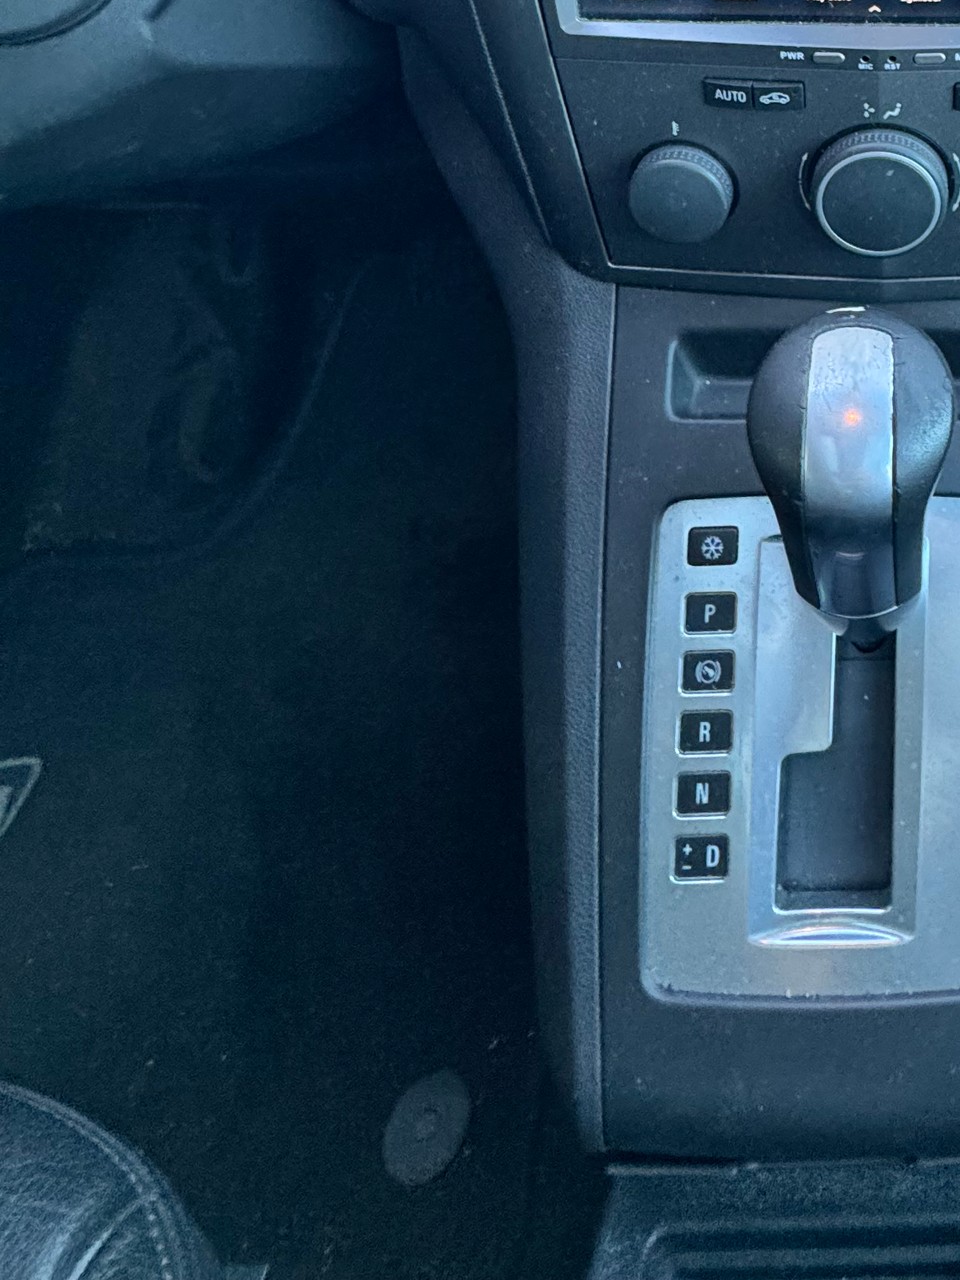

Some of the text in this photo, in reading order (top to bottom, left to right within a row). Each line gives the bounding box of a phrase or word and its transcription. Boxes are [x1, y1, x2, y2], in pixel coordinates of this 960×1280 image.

[779, 51, 805, 61] PWR
[858, 63, 874, 71] MIC
[884, 63, 901, 71] RST
[714, 88, 747, 104] AUTO
[703, 603, 717, 625] P
[698, 721, 712, 743] R
[695, 782, 710, 806] N
[705, 844, 721, 868] D
